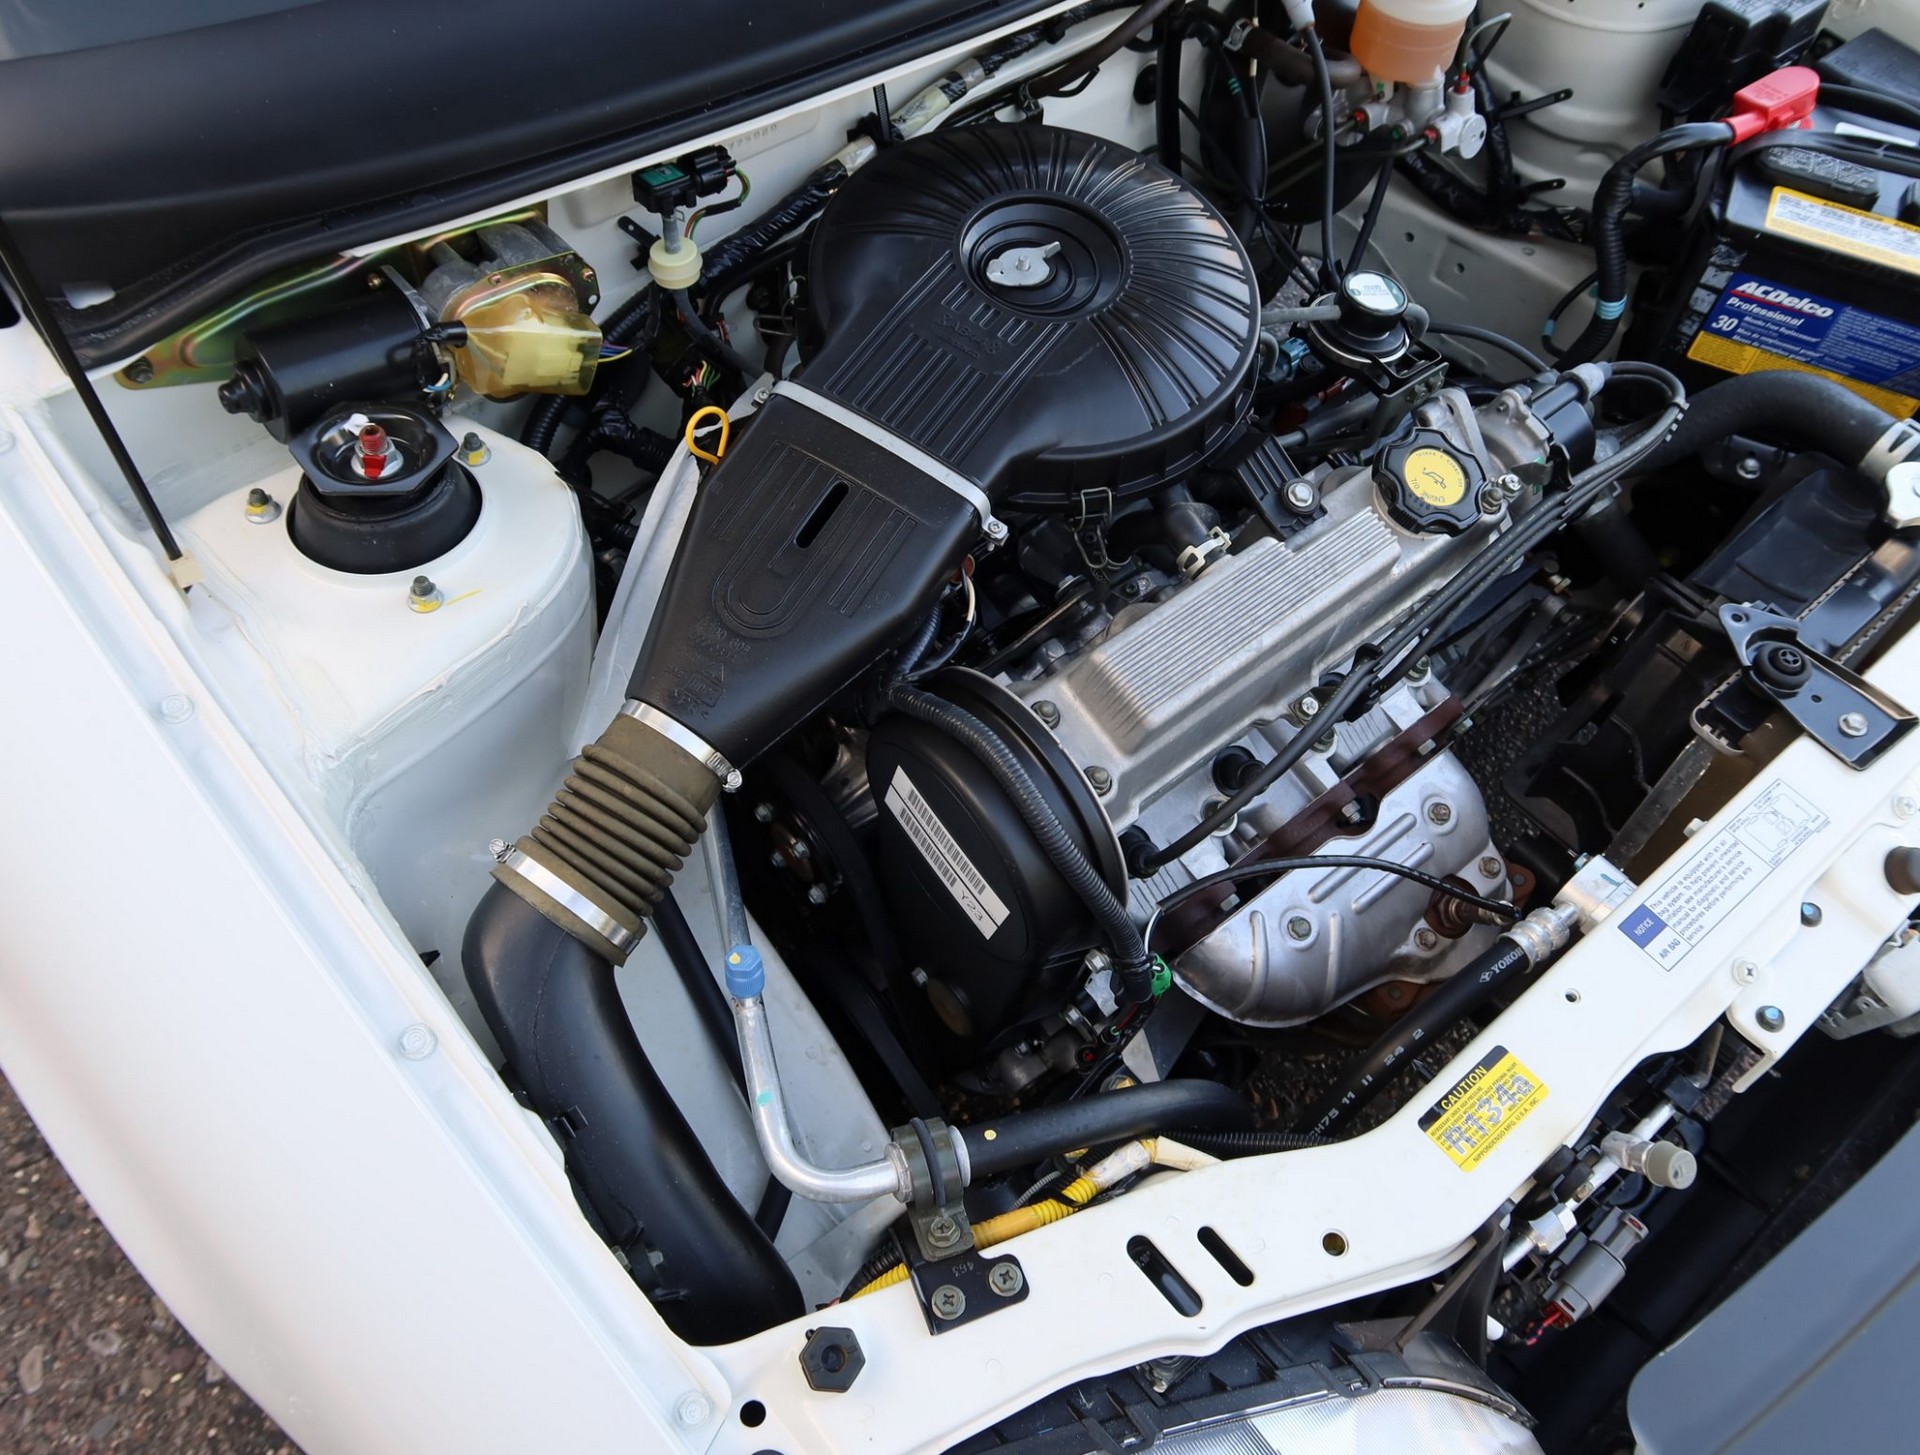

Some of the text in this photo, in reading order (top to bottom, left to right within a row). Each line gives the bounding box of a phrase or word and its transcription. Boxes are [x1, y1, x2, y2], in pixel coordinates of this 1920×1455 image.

[1726, 297, 1805, 326] Professional
[1735, 281, 1834, 318] ACDelco
[1711, 315, 1739, 332] 30
[1649, 898, 1663, 911] This
[1659, 883, 1678, 901] vehicle
[1681, 860, 1705, 883] equipped
[1657, 906, 1669, 917] bag
[1689, 873, 1703, 887] help
[1700, 858, 1719, 877] prevent
[1716, 838, 1739, 861] unwanted
[1671, 911, 1690, 929] manual
[1694, 882, 1720, 908] diagnostic
[1717, 873, 1729, 885] and
[1727, 858, 1744, 876] service
[1683, 895, 1694, 905] see
[1724, 848, 1742, 866] service
[961, 890, 983, 922] Y23
[1633, 916, 1654, 937] NOTICE
[1679, 910, 1706, 936] procedures
[1702, 895, 1720, 912] before
[1717, 873, 1744, 899] performing
[1658, 937, 1681, 960] AIR BAG
[1412, 1029, 1424, 1040] 2
[1439, 1064, 1487, 1111] CAUTION
[1442, 1074, 1536, 1155] R134a
[1472, 1128, 1506, 1163] NIPPONDENSO
[1503, 1118, 1516, 1132] MFG.
